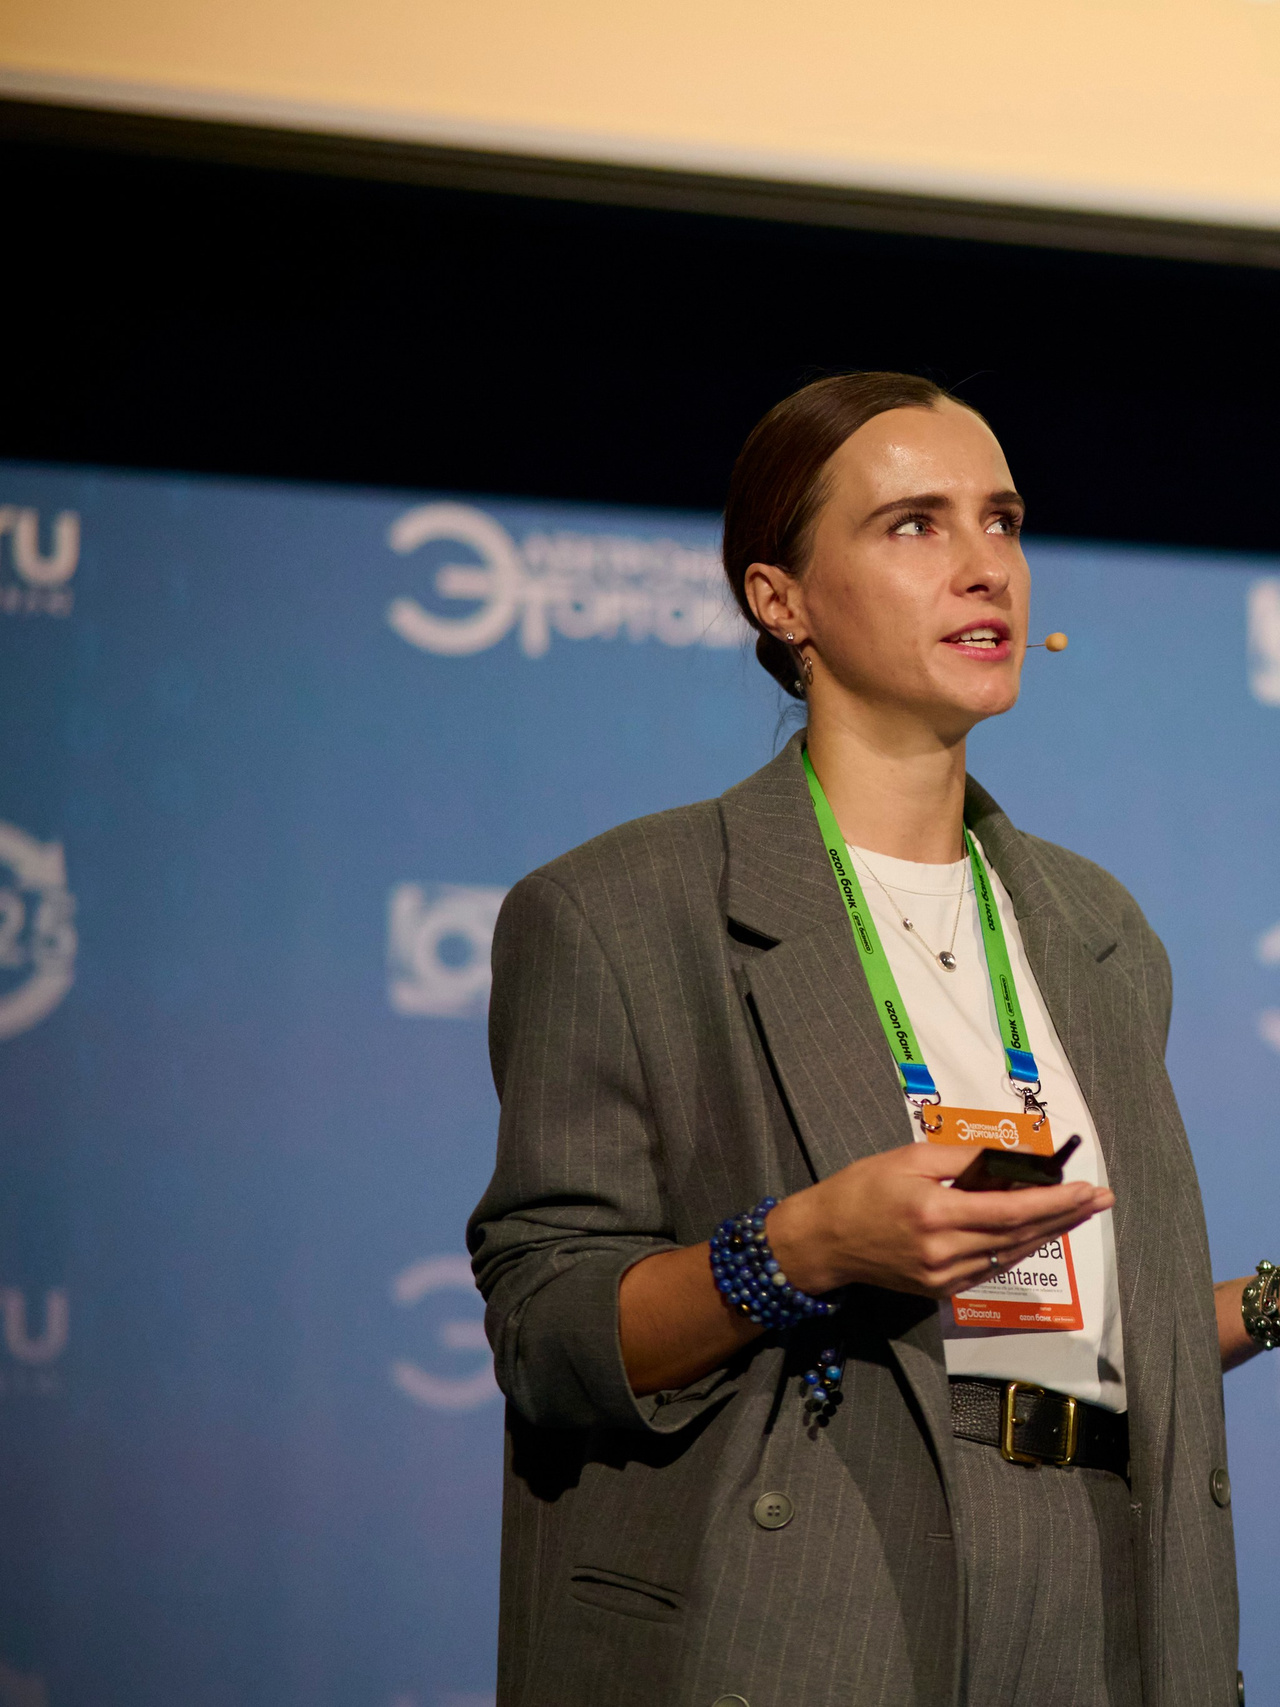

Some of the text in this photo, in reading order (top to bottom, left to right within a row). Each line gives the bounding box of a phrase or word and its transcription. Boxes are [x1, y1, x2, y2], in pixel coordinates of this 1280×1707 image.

[829, 849, 857, 909] ozon банк
[885, 1000, 914, 1061] ozon банк
[1009, 1019, 1021, 1049] банк
[998, 1128, 1020, 1140] 2025
[967, 1308, 1001, 1319] Oborot.ru
